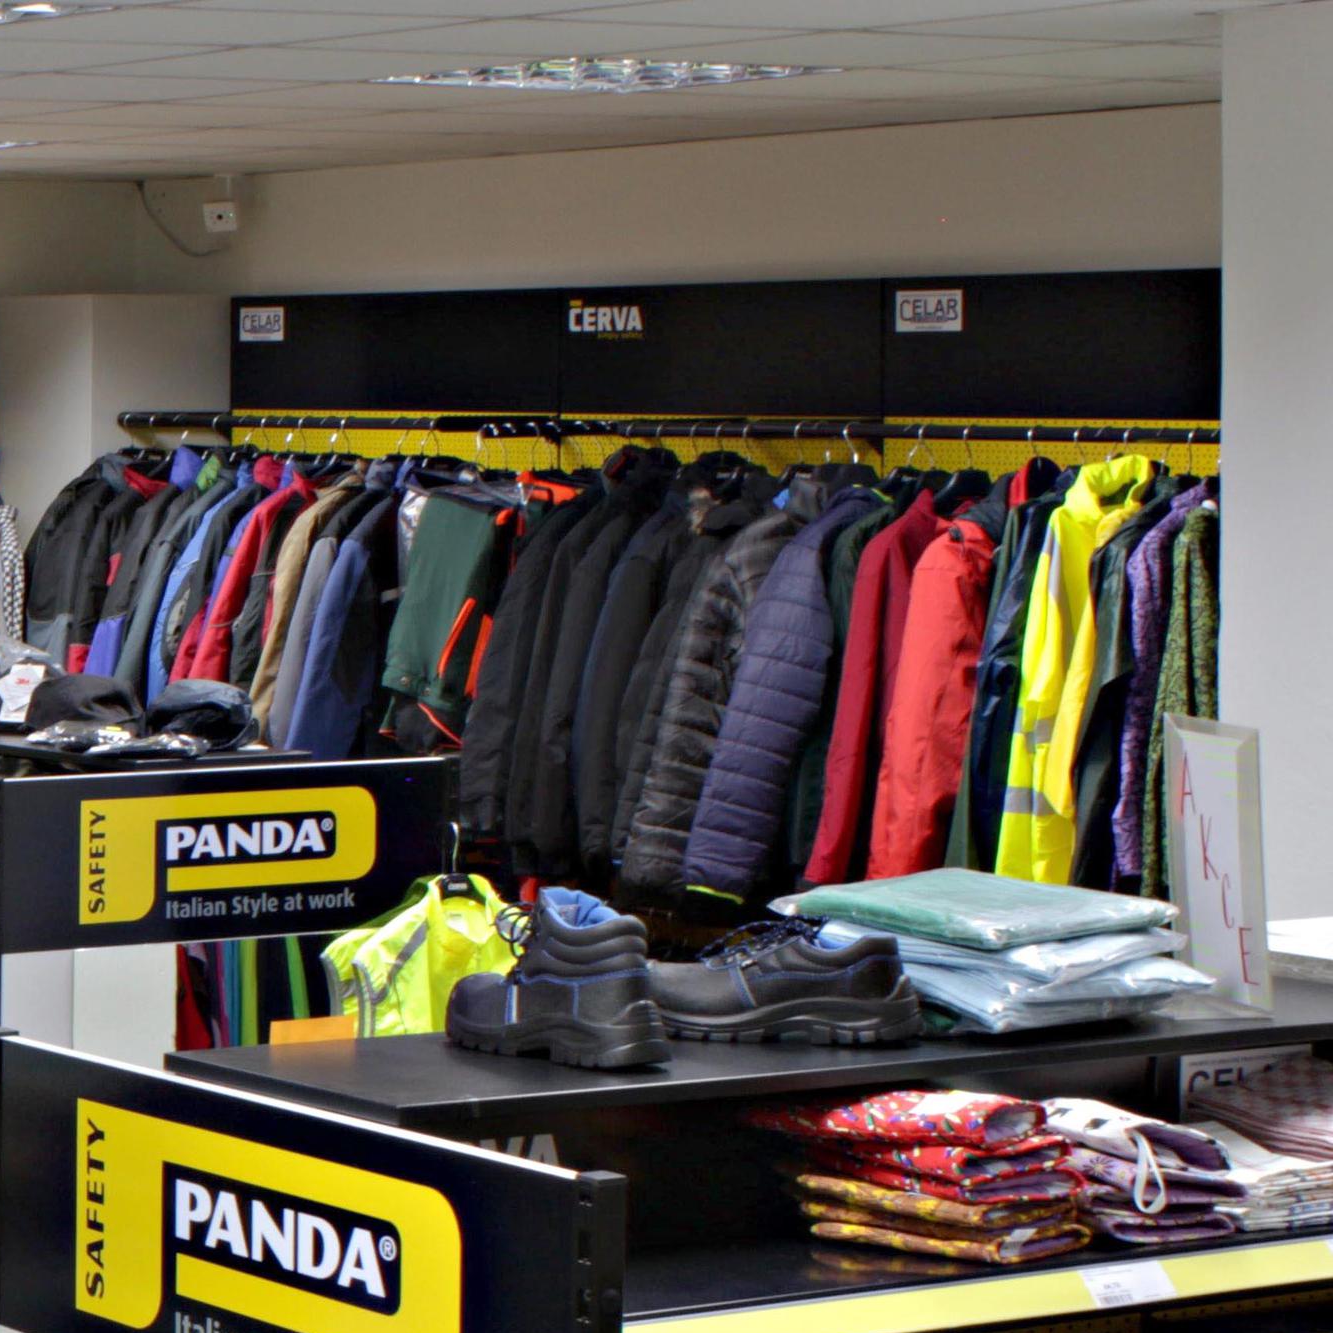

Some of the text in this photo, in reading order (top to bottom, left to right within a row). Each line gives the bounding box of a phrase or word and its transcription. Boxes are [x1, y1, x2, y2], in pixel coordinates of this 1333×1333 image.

[900, 297, 959, 322] CELAR
[88, 810, 107, 914] SAFETY
[166, 887, 356, 919] Italian Style at work
[86, 1118, 106, 1300] SAFETY
